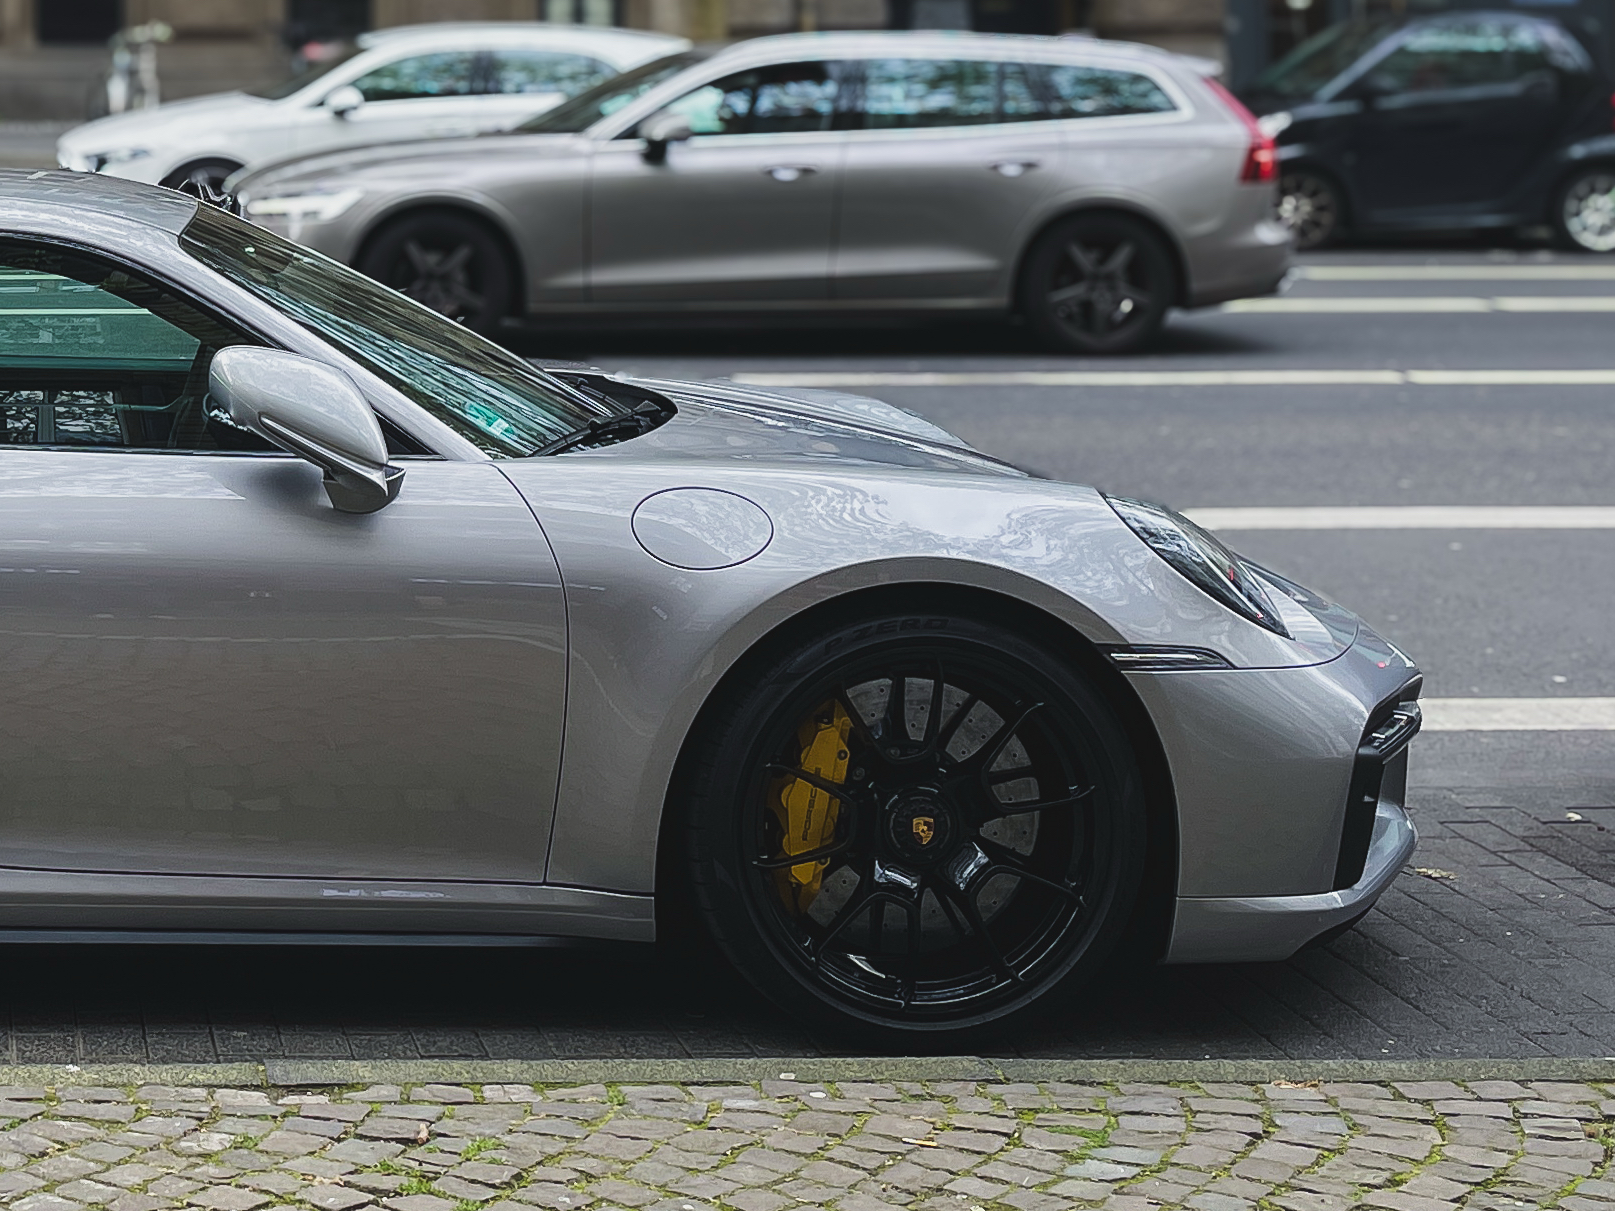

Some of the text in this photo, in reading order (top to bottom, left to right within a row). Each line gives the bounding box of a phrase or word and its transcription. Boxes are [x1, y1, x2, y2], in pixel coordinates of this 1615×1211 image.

[823, 618, 950, 656] P ZERO
[801, 766, 822, 841] PORSCE
